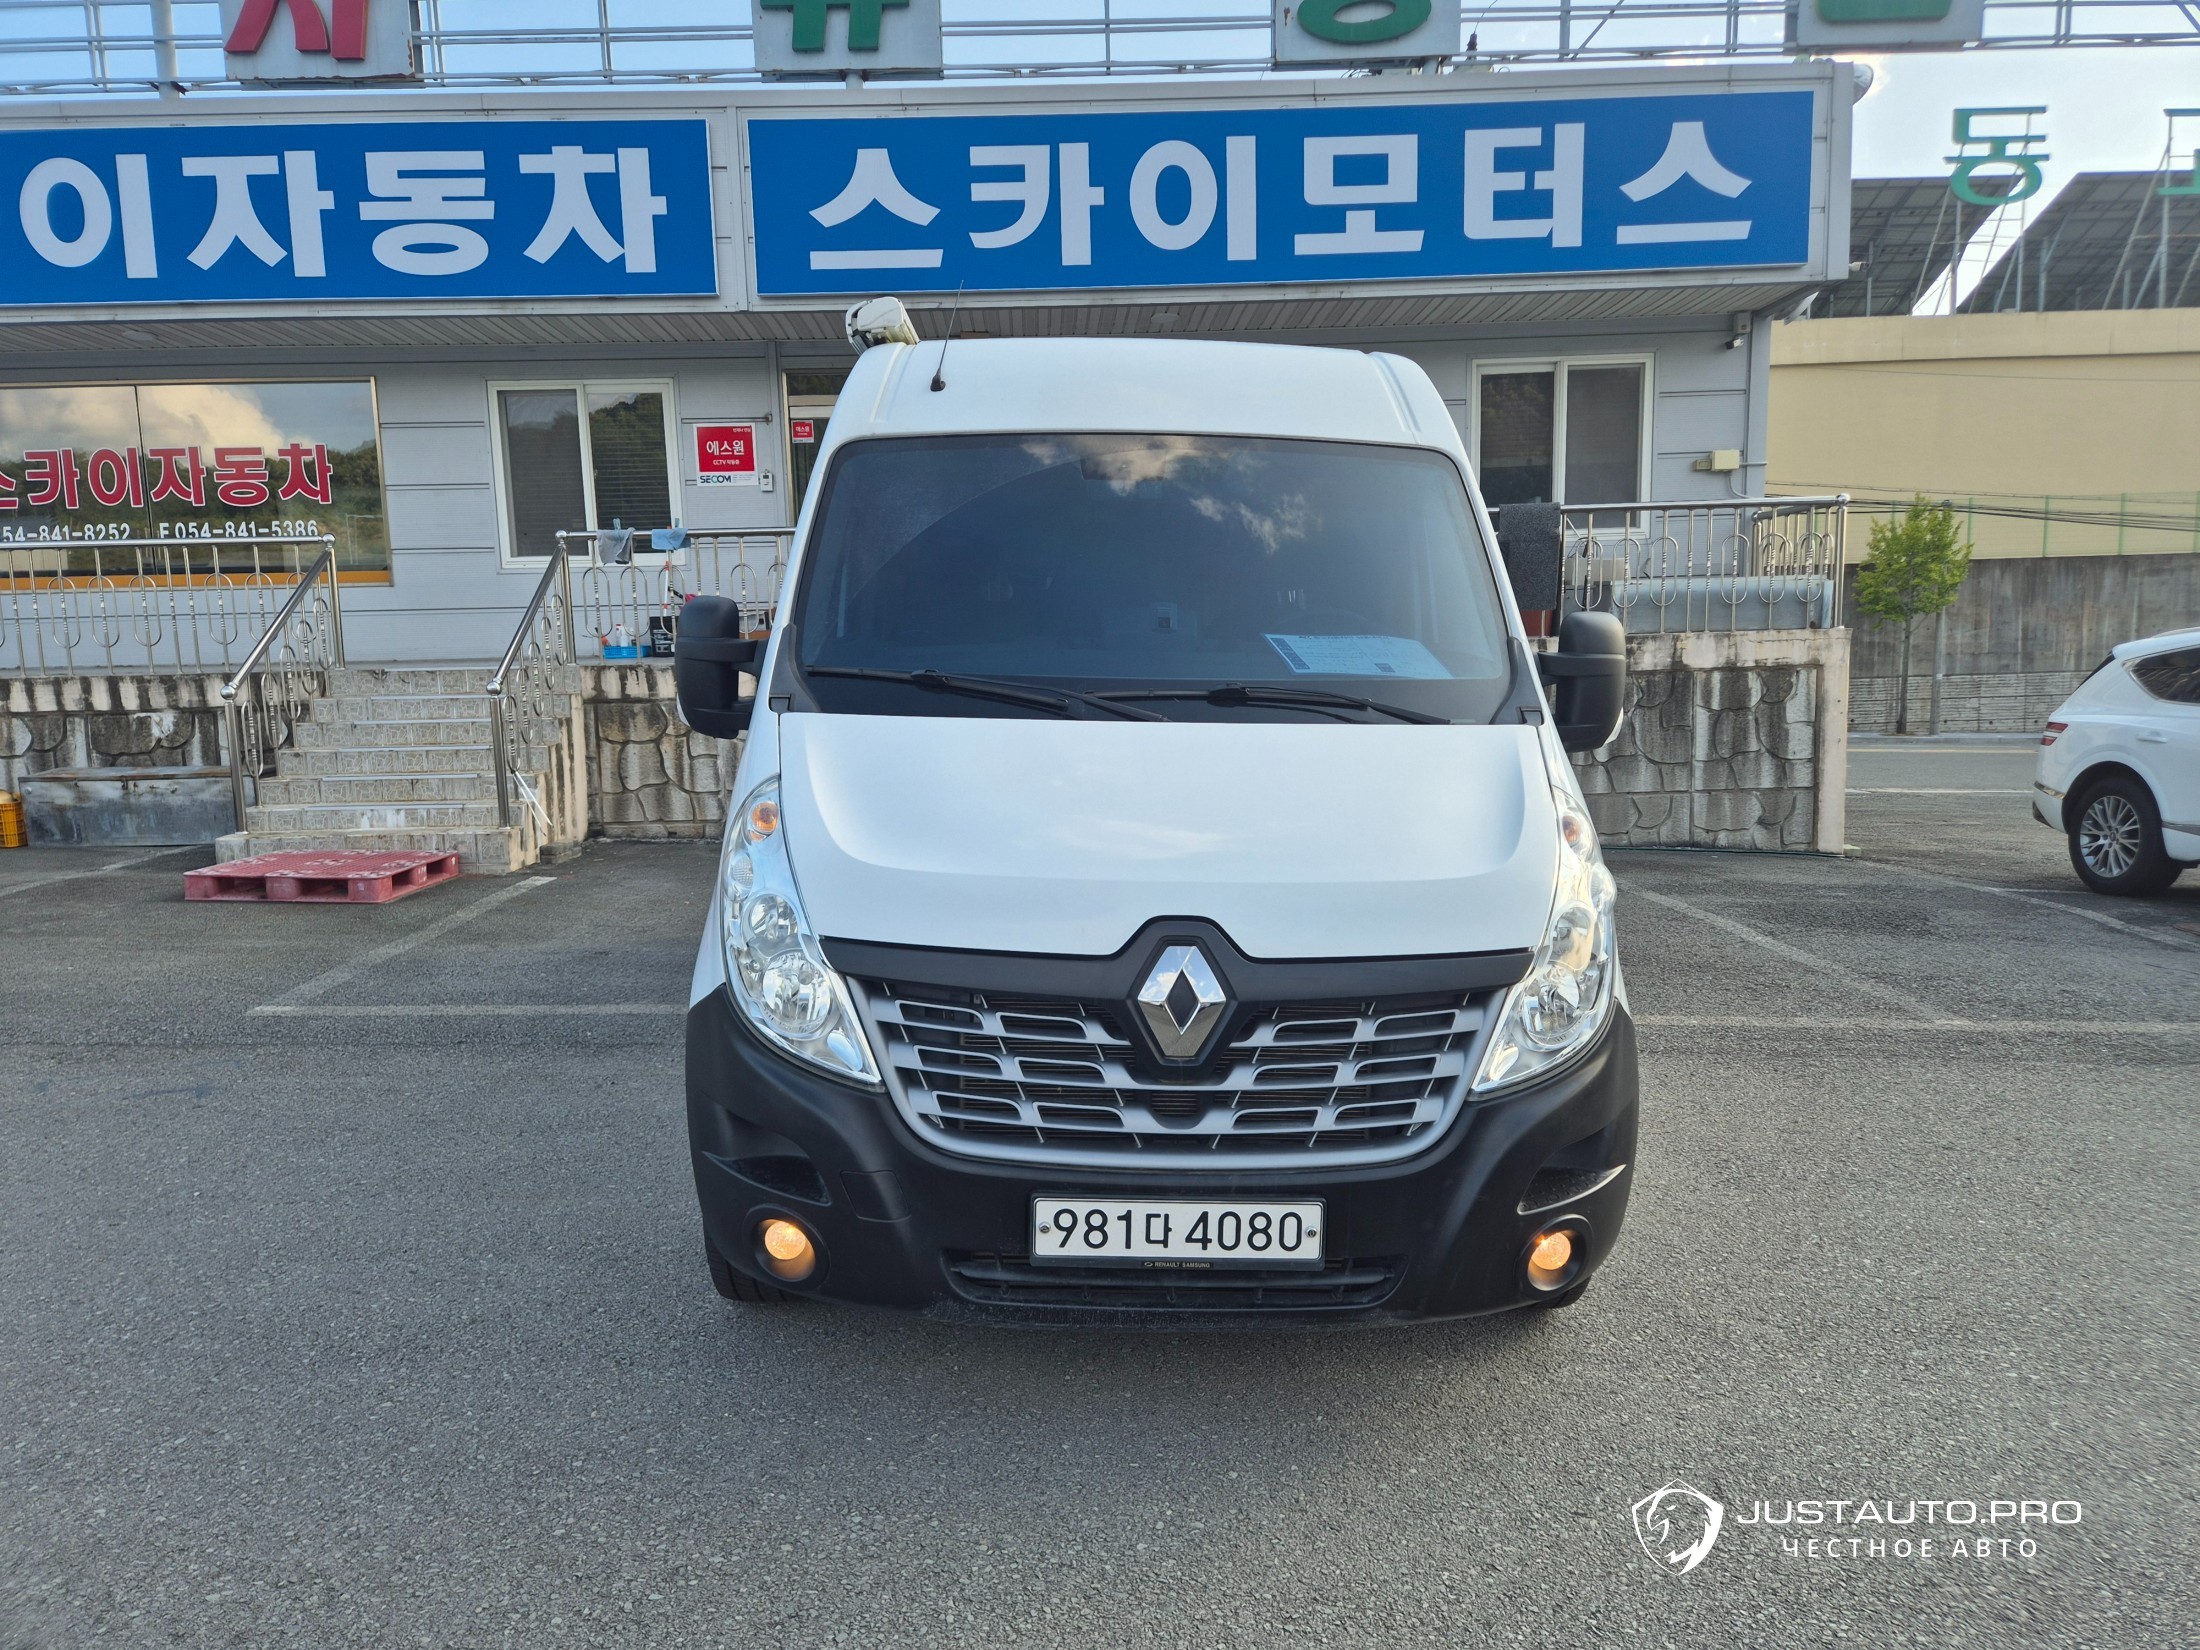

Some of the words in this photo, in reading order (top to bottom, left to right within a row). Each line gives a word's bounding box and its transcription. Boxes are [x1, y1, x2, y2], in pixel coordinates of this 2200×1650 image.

[19, 145, 667, 279] 이자동차
[808, 120, 1753, 270] 스카이모터스
[700, 475, 732, 484] SECOM
[706, 439, 745, 456] 에스원
